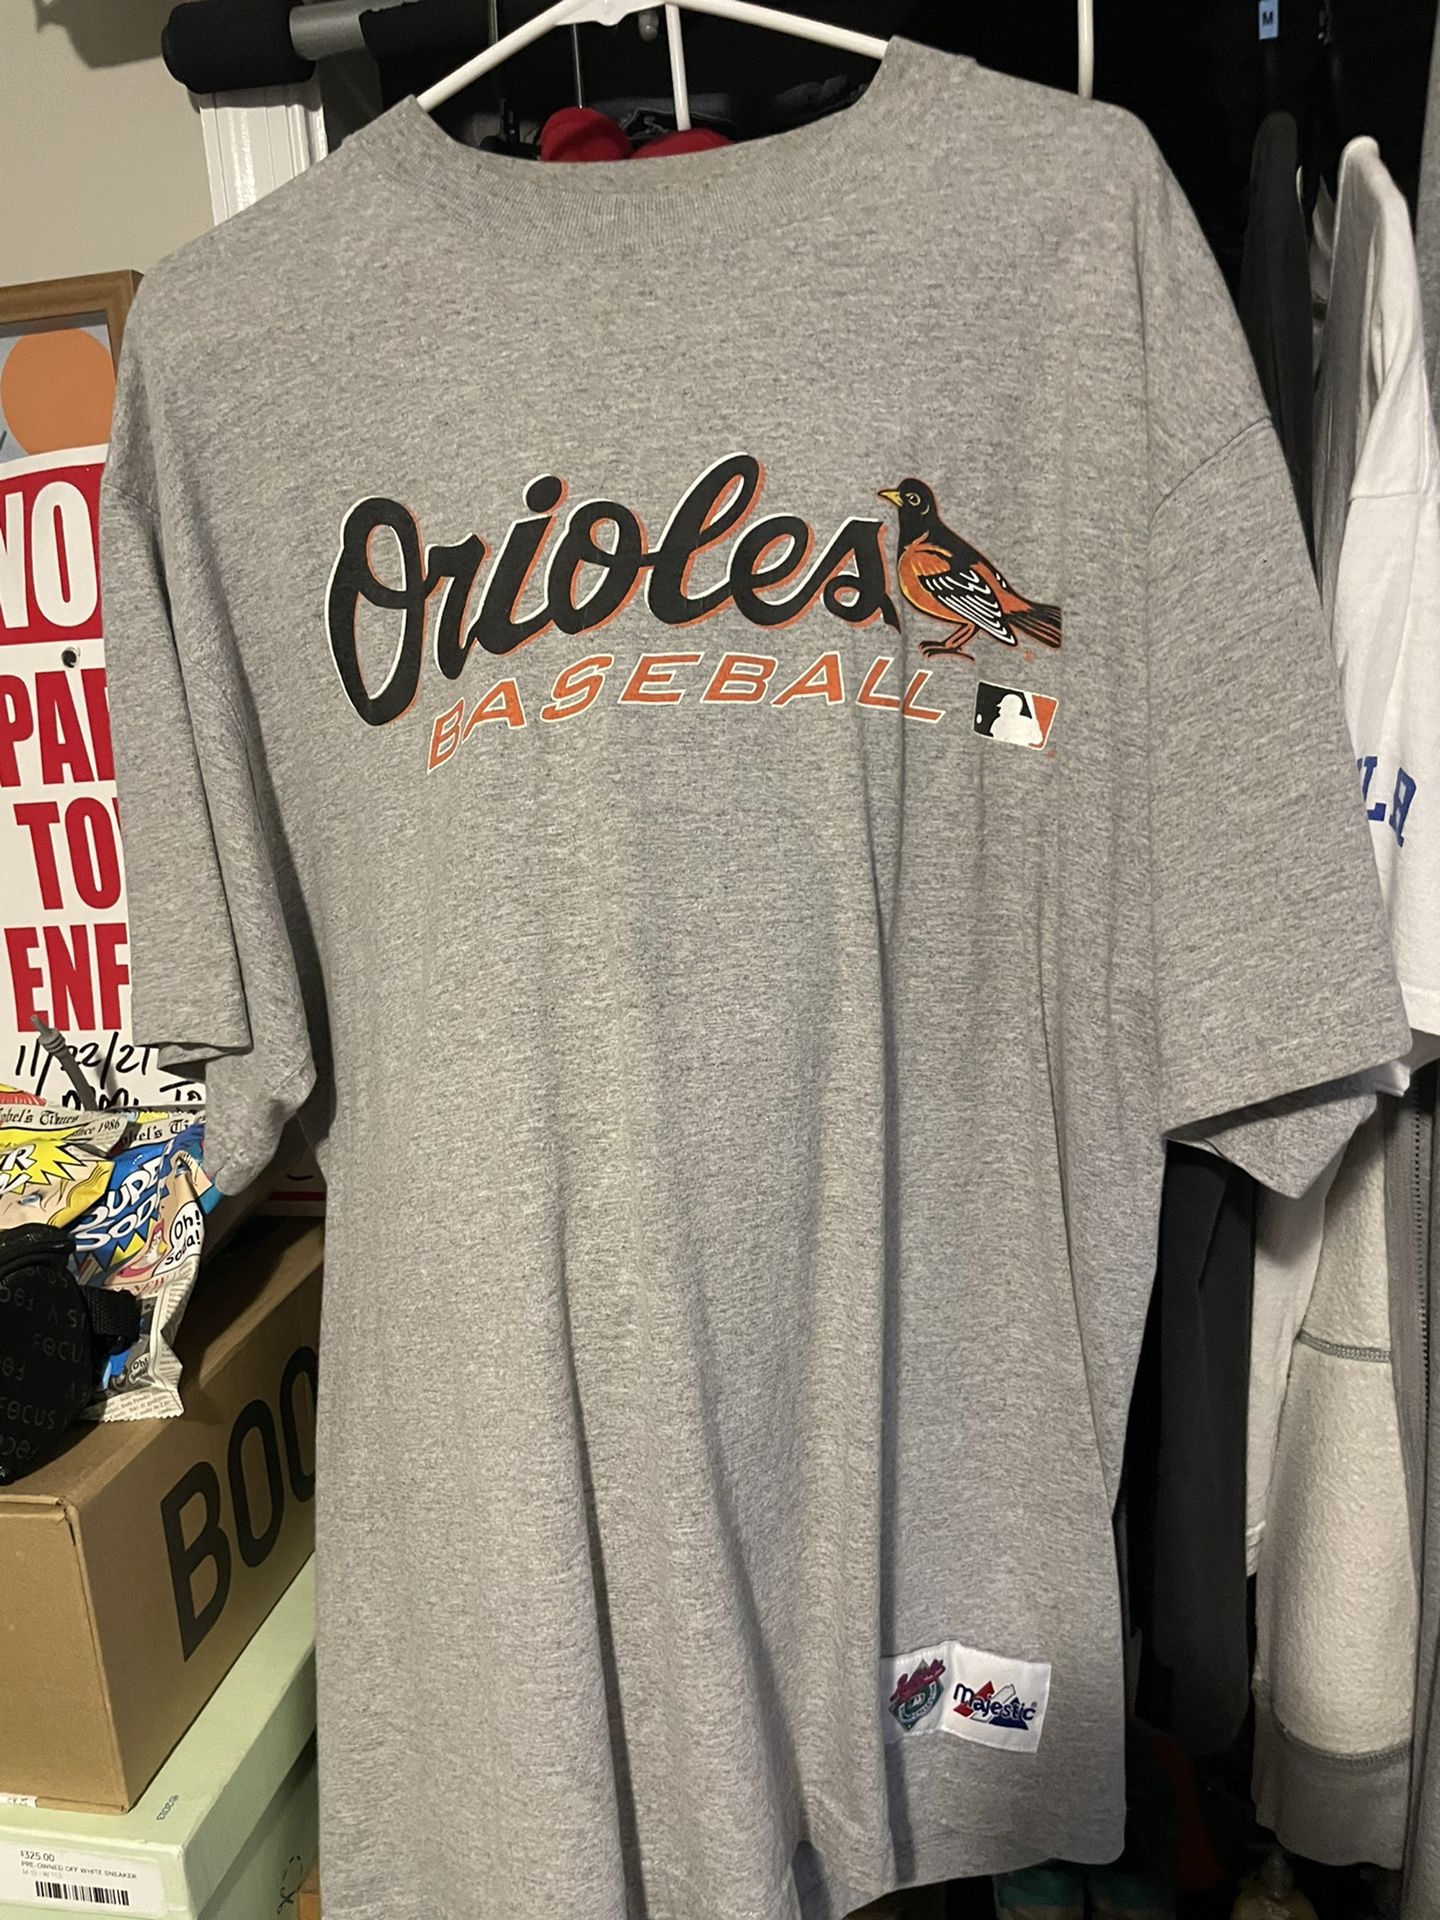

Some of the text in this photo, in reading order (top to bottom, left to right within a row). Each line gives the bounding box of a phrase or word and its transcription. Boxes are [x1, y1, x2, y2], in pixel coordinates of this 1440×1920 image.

[1262, 12, 1274, 25] M
[325, 452, 901, 726] Orioles
[427, 650, 947, 774] BASEBALL
[13, 796, 122, 911] TO
[98, 1117, 121, 1135] 1986
[174, 1210, 201, 1240] Oh!
[20, 1850, 55, 1862] $325.00
[21, 1861, 63, 1871] PRE-OWNED
[80, 1867, 102, 1876] WHITE
[104, 1870, 137, 1879] SNEAKER
